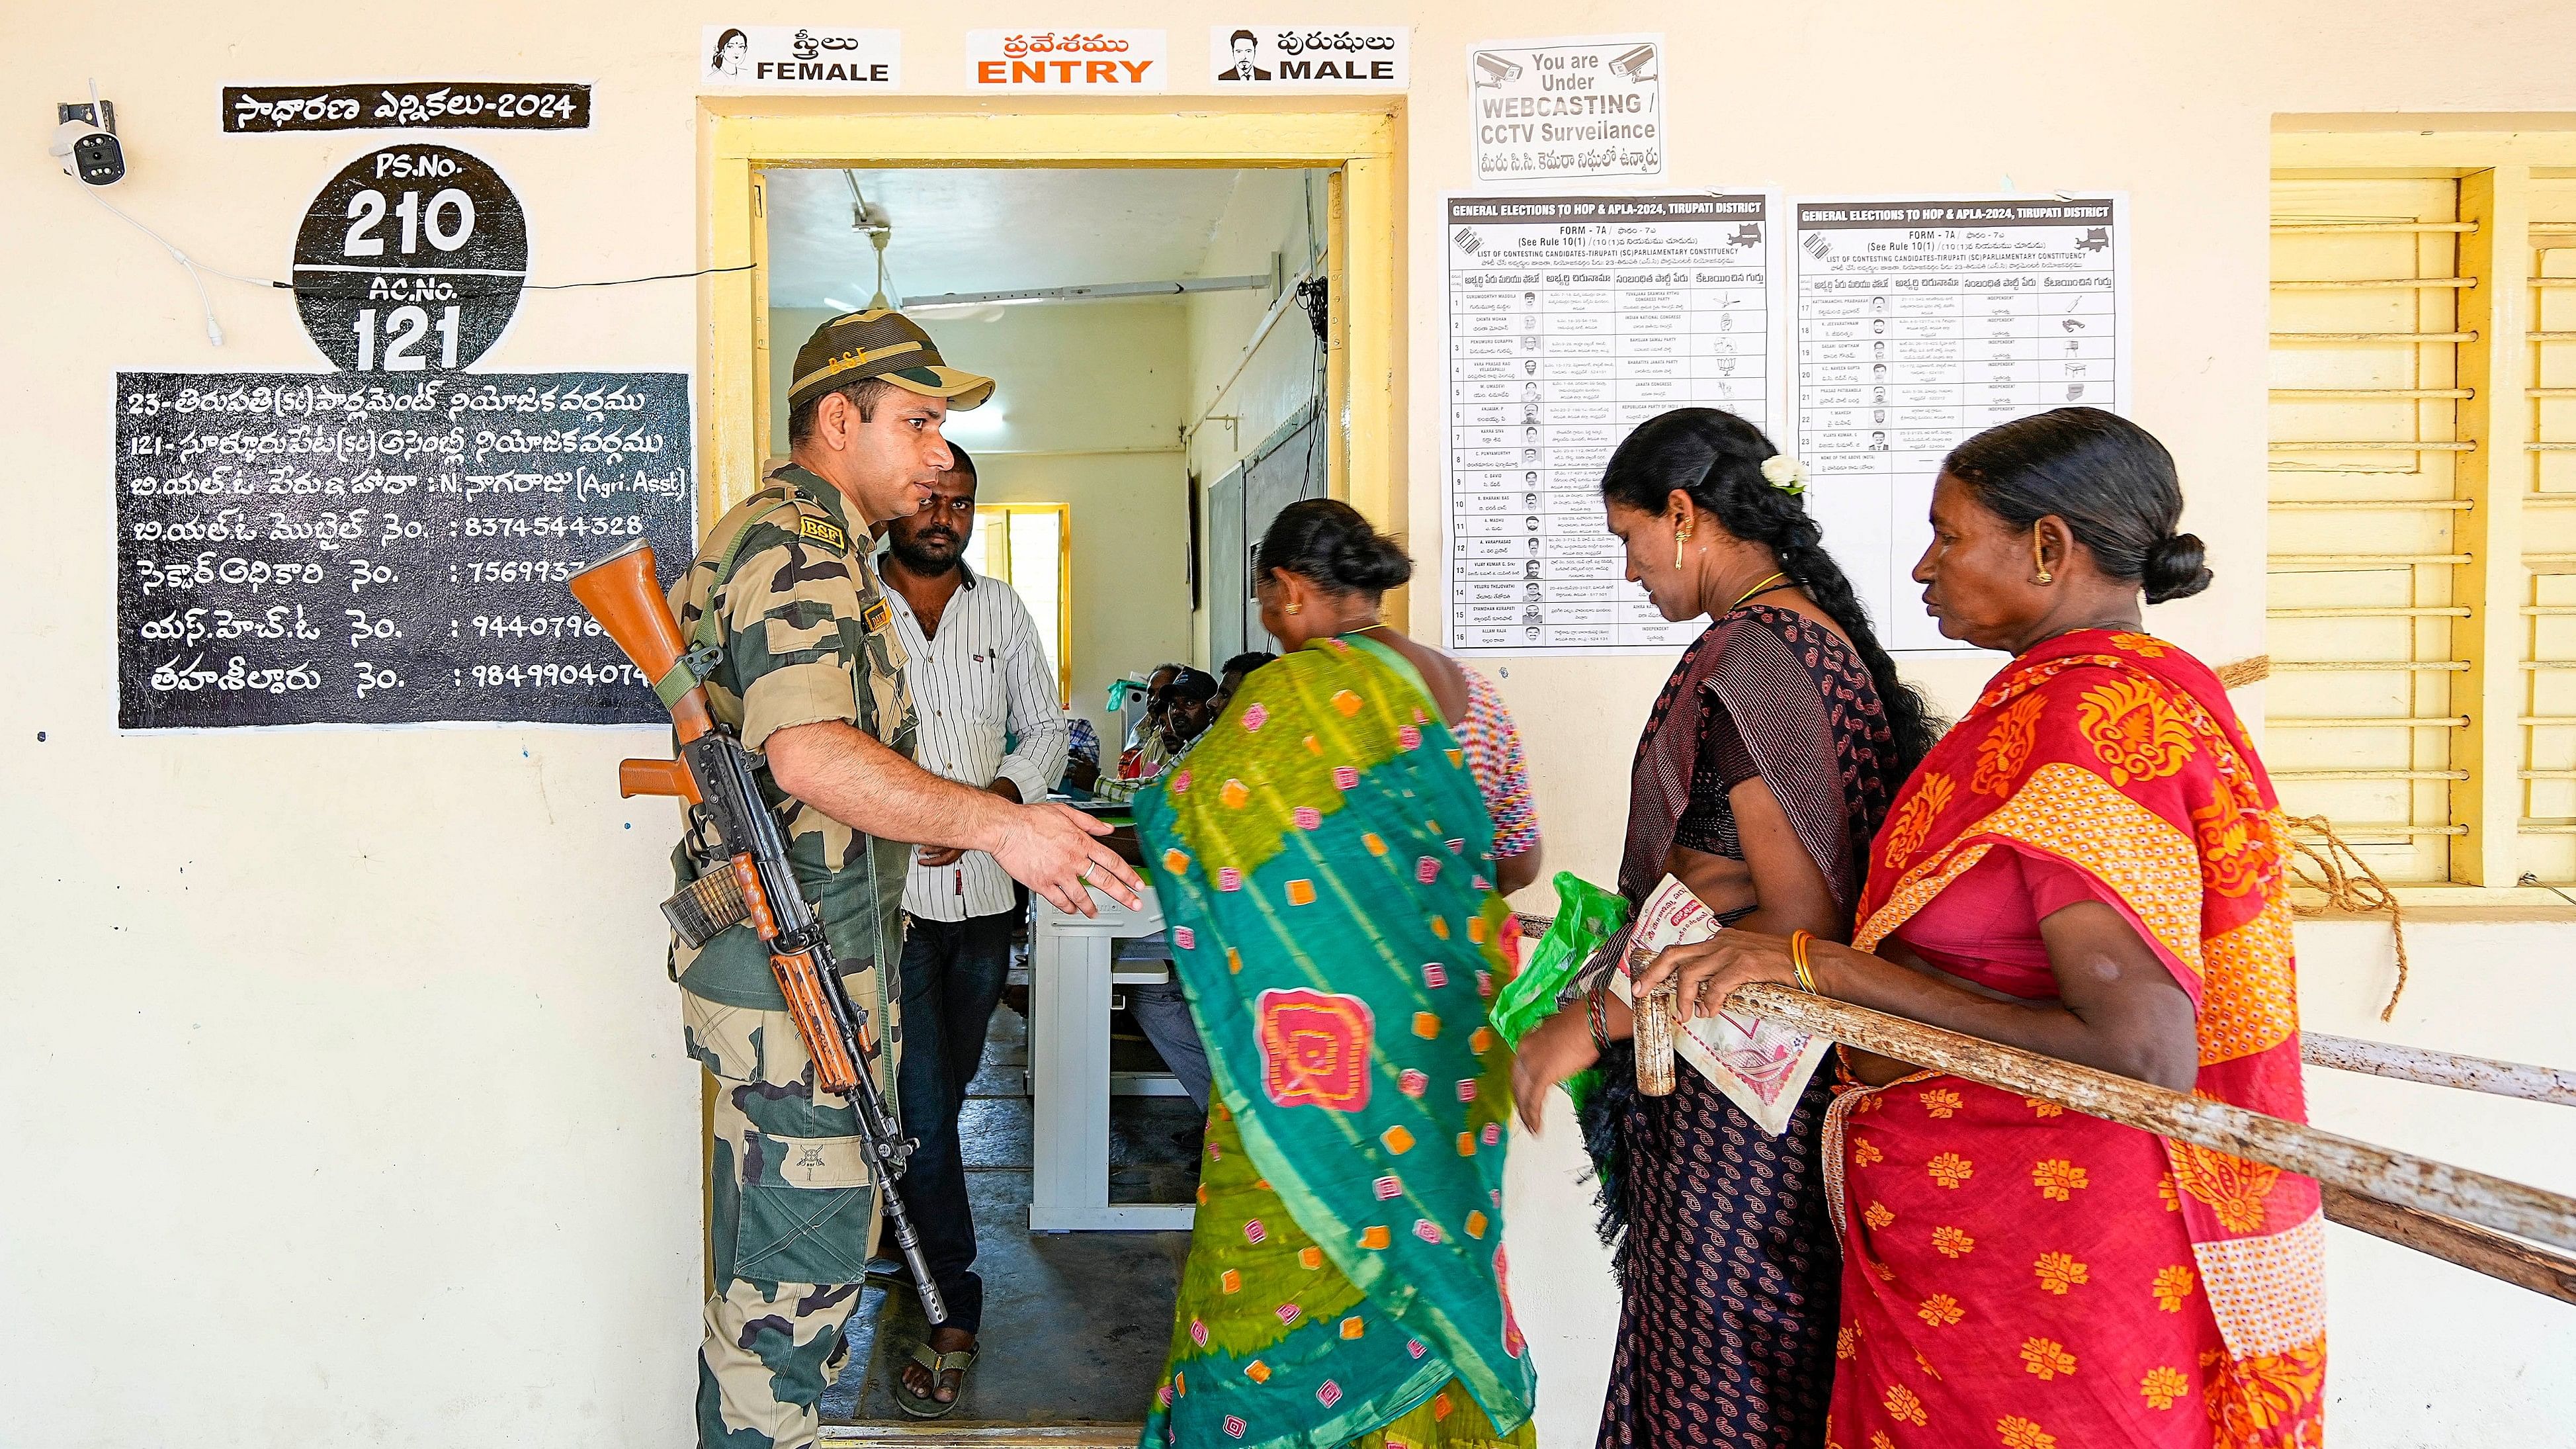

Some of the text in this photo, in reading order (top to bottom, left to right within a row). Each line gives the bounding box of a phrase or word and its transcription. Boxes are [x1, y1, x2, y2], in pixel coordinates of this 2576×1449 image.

[793, 29, 858, 60] స్త్రీలు
[1004, 32, 1129, 58] ప్రవేశము
[1277, 31, 1395, 56] పురుషులు
[757, 62, 888, 82] FEMALE
[978, 61, 1154, 83] ENTRY
[1280, 61, 1394, 79] MALE
[1531, 54, 1599, 70] You are
[1542, 73, 1594, 91] Under
[236, 93, 360, 128] సాధారణ
[1482, 93, 1654, 118] WEBCASTING /
[1481, 120, 1655, 144] CCTV Surveilance
[376, 154, 462, 179] PS.No.
[1482, 154, 1508, 172] మీరు
[1620, 147, 1658, 172] ఉన్నారు
[1453, 202, 1761, 216] GENERAL ELECTIONS TO HOP & APLA-2024, TIRUPATI DISTRICT
[1802, 206, 2109, 222] GENERAL ELECTIONS TO HOP & APLA-2024, TIRUPATI DISTRICT
[344, 188, 475, 257] 210
[1518, 238, 1538, 247] (See
[1541, 238, 1560, 246] Rule
[1563, 237, 1586, 247] 10(1)
[1909, 230, 1934, 239] FORM
[1868, 241, 1935, 252] (See Rule 10(1)
[370, 277, 458, 301] AC.No.
[1572, 273, 1611, 283] చిరునామా
[1673, 273, 1688, 283] పేరు
[354, 305, 460, 373] 121
[268, 465, 321, 494] పేరు
[465, 516, 643, 537] 8374544328
[805, 521, 839, 542] BSF
[472, 664, 648, 688] 9849904074
